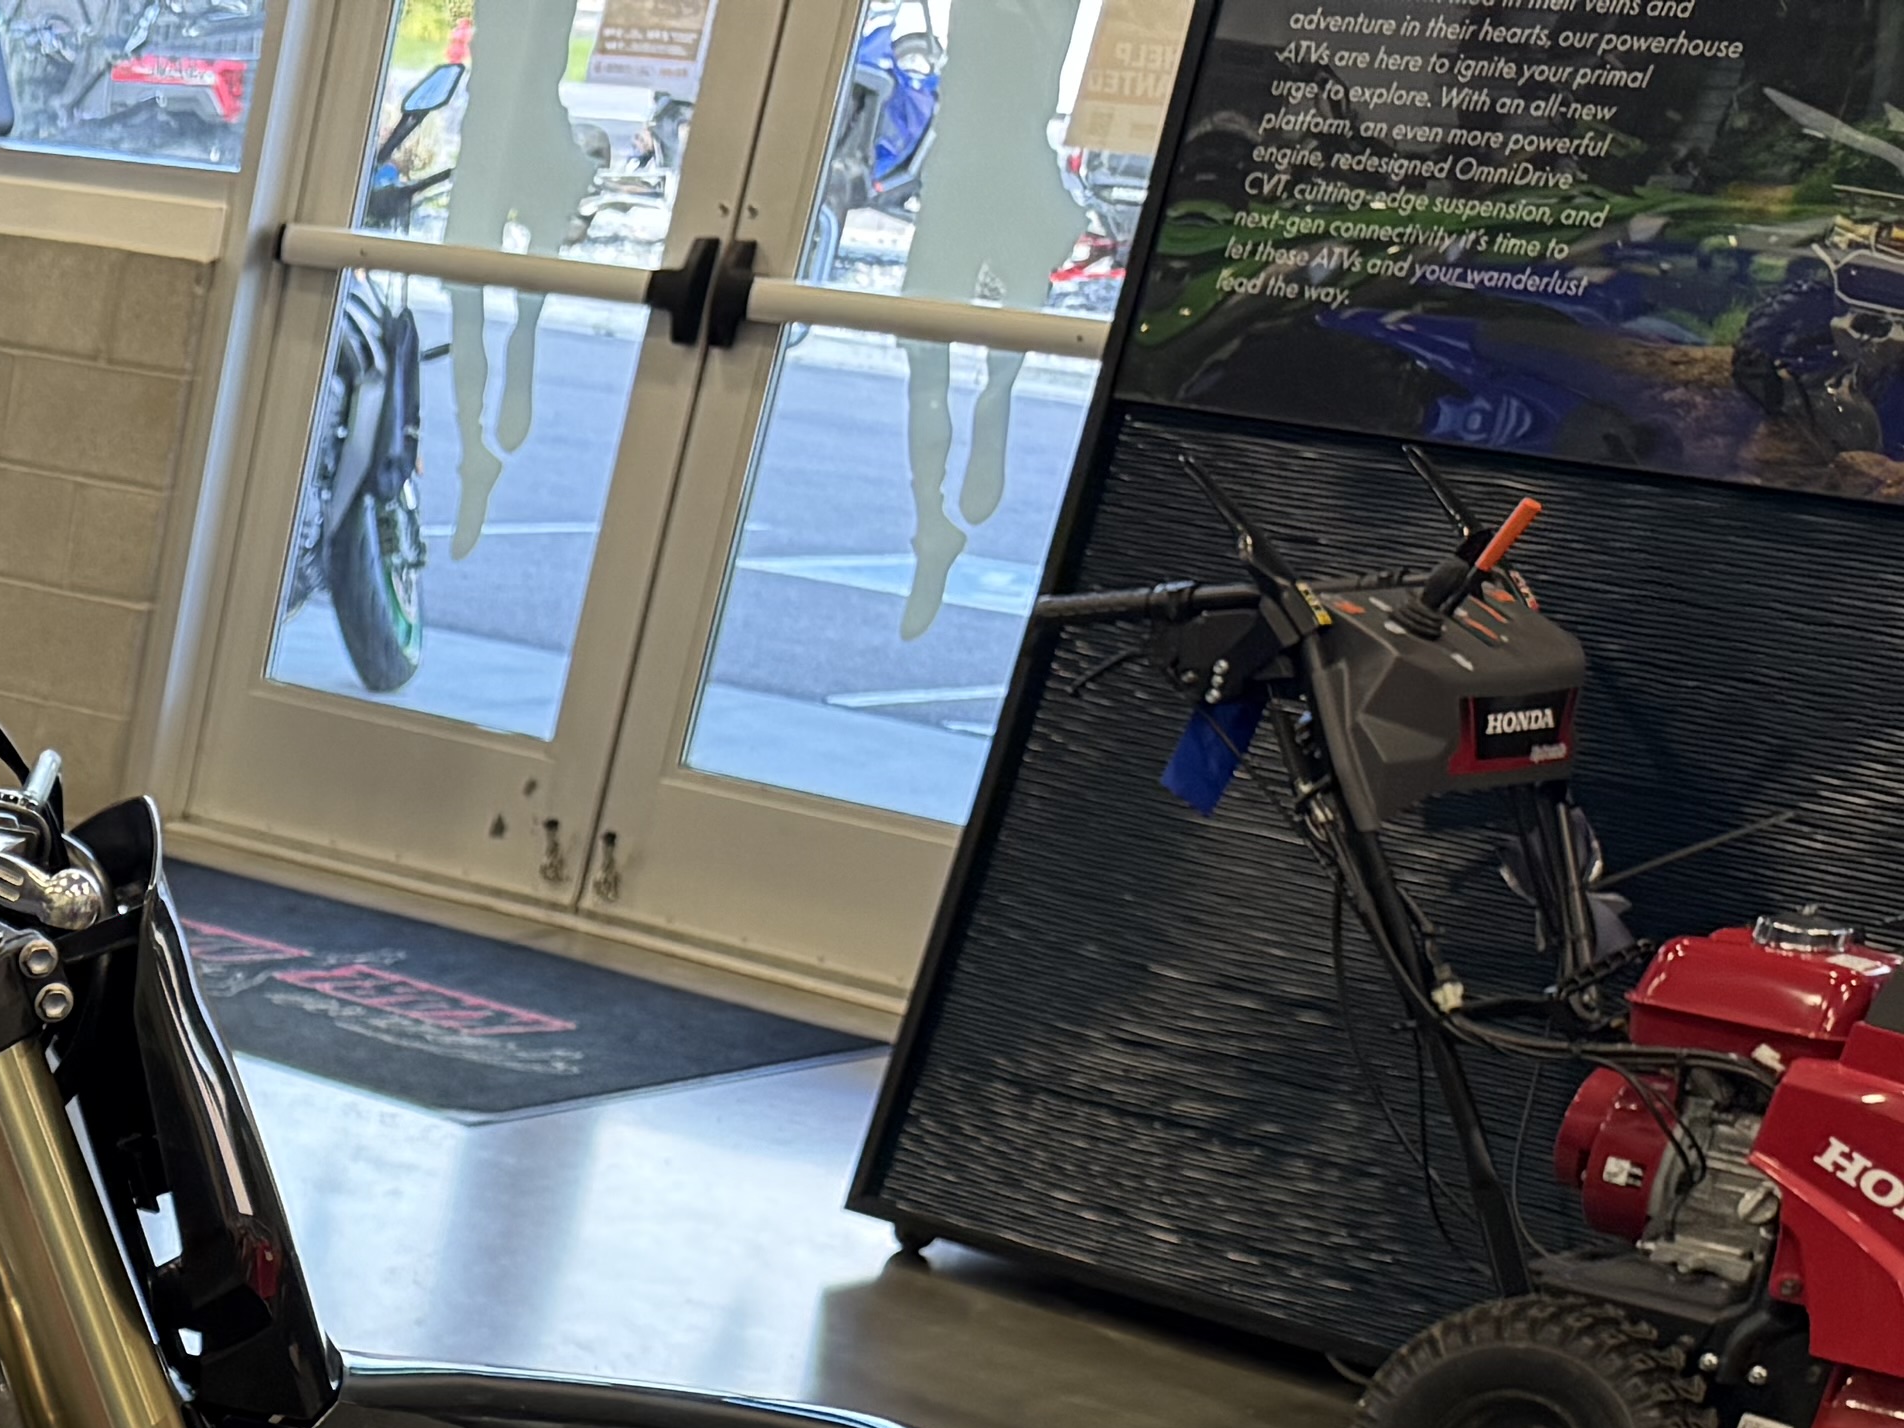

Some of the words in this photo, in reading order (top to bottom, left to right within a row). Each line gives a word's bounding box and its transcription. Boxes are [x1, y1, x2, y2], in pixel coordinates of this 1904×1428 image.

[1289, 10, 1396, 38] adventure
[1400, 16, 1418, 37] in
[1425, 17, 1476, 42] their
[1477, 23, 1552, 49] hearts,
[1558, 31, 1598, 50] our
[1598, 31, 1743, 59] powerhouse
[1279, 42, 1329, 68] ATVs
[1334, 49, 1370, 69] are
[1374, 46, 1422, 73] here
[1427, 53, 1450, 75] to
[1453, 54, 1516, 84] ignite
[1515, 64, 1574, 86] your
[1573, 63, 1654, 90] primal
[1270, 80, 1319, 103] urge
[1322, 81, 1345, 102] to
[1349, 84, 1432, 109] explore.
[1440, 86, 1491, 112] With
[1496, 95, 1524, 114] an
[1529, 93, 1618, 122] all-new
[1259, 109, 1354, 139] platform,
[1359, 120, 1388, 141] an
[1392, 123, 1443, 143] even
[1448, 126, 1502, 149] more
[1505, 131, 1612, 158] powerful
[1251, 144, 1325, 171] engine,
[1330, 150, 1453, 181] redesigned
[1455, 157, 1573, 189] OmniDrive
[1245, 171, 1289, 199] CVT,
[1293, 180, 1429, 214] cutting-edge
[1432, 195, 1555, 227] suspension,
[1560, 204, 1609, 230] and
[1233, 211, 1326, 238] next-gen
[1329, 218, 1455, 251] connectivity
[1458, 229, 1487, 251] it's
[1493, 231, 1539, 258] time
[1545, 237, 1569, 261] to
[1215, 266, 1265, 295] lead
[1267, 274, 1299, 299] the
[1303, 280, 1350, 308] way.
[1224, 238, 1249, 261] let
[1312, 248, 1361, 274] ATVs
[1365, 254, 1410, 278] and
[1410, 259, 1464, 287] your
[1465, 265, 1590, 297] wanderlust
[1484, 707, 1556, 737] HONDA
[1811, 1135, 1904, 1215] HO
